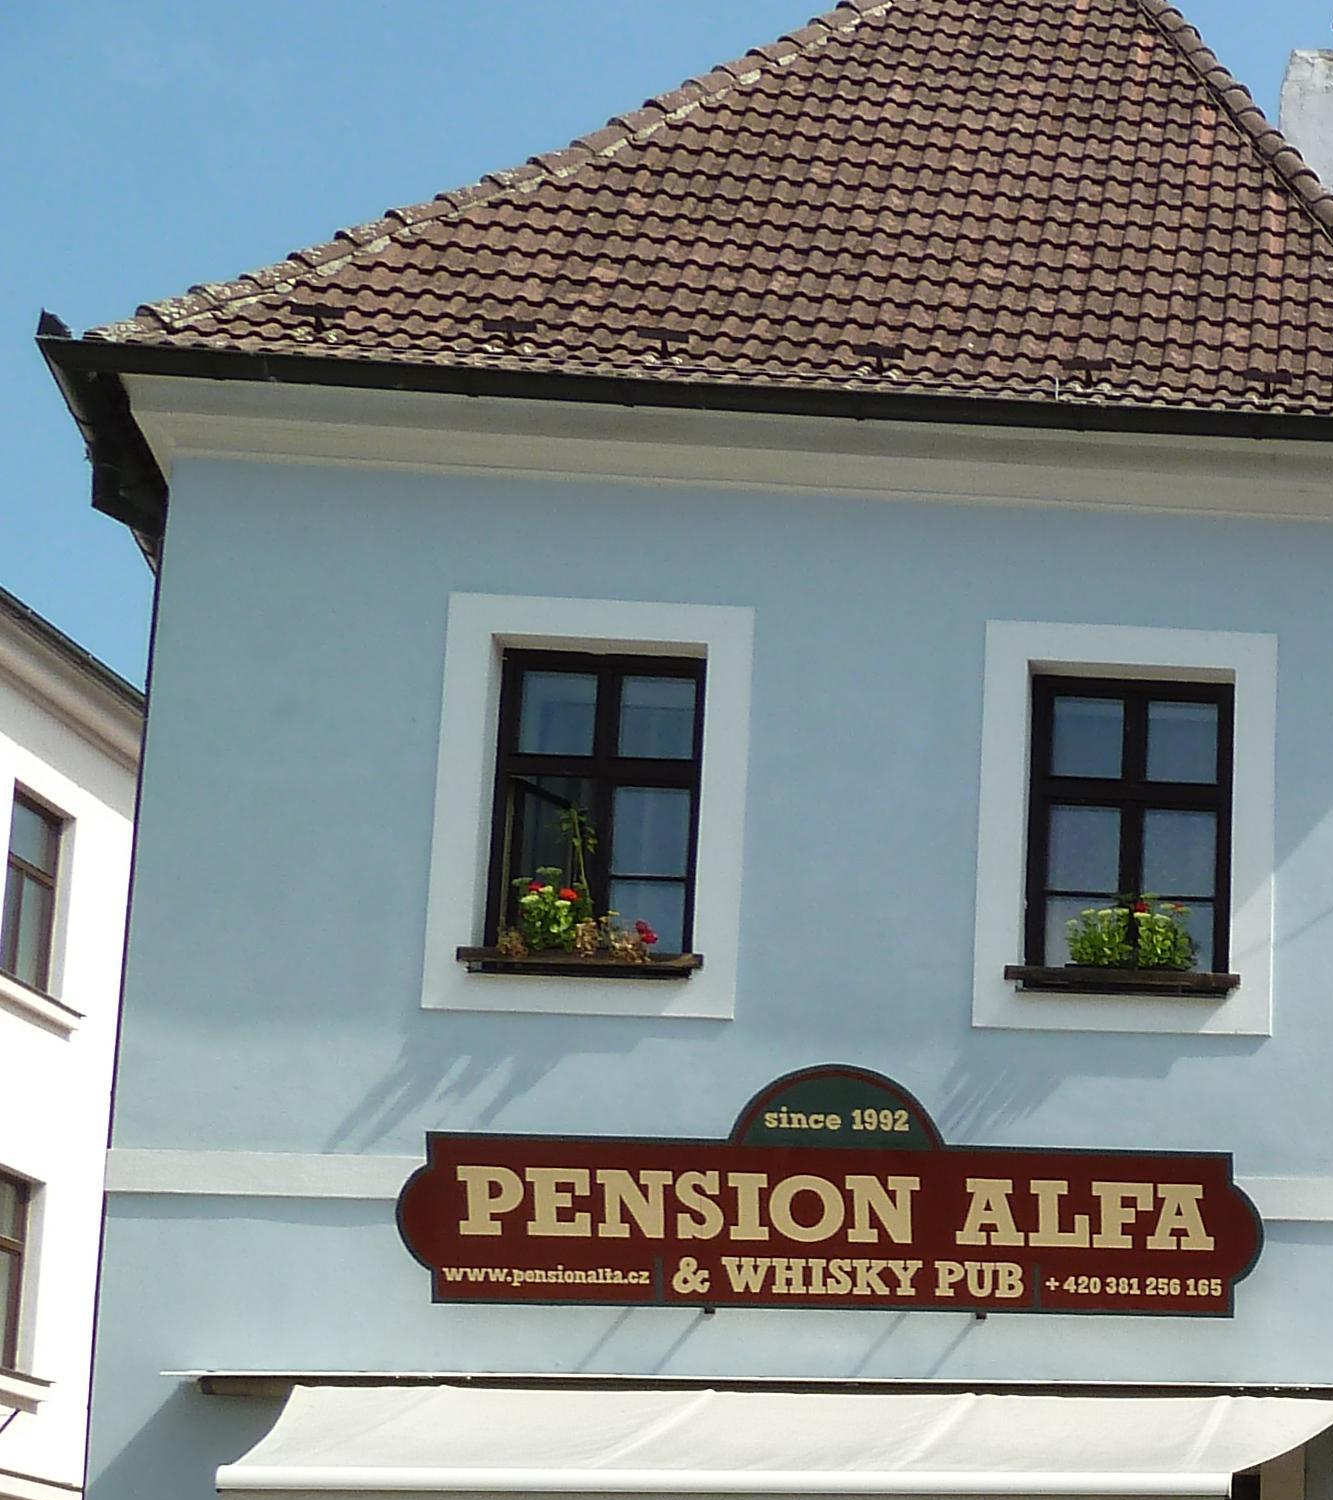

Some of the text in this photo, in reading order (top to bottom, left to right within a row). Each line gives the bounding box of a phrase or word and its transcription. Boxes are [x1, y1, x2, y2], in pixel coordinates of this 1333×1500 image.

[764, 1106, 910, 1132] since 1992
[456, 1165, 1215, 1251] PENSION ALFA
[442, 1265, 650, 1287] www.pensionalfa.cz
[672, 1256, 1025, 1299] & WHISKY PUB
[1105, 1277, 1141, 1295] 381
[1145, 1277, 1181, 1296] 256
[1186, 1279, 1223, 1297] 165
